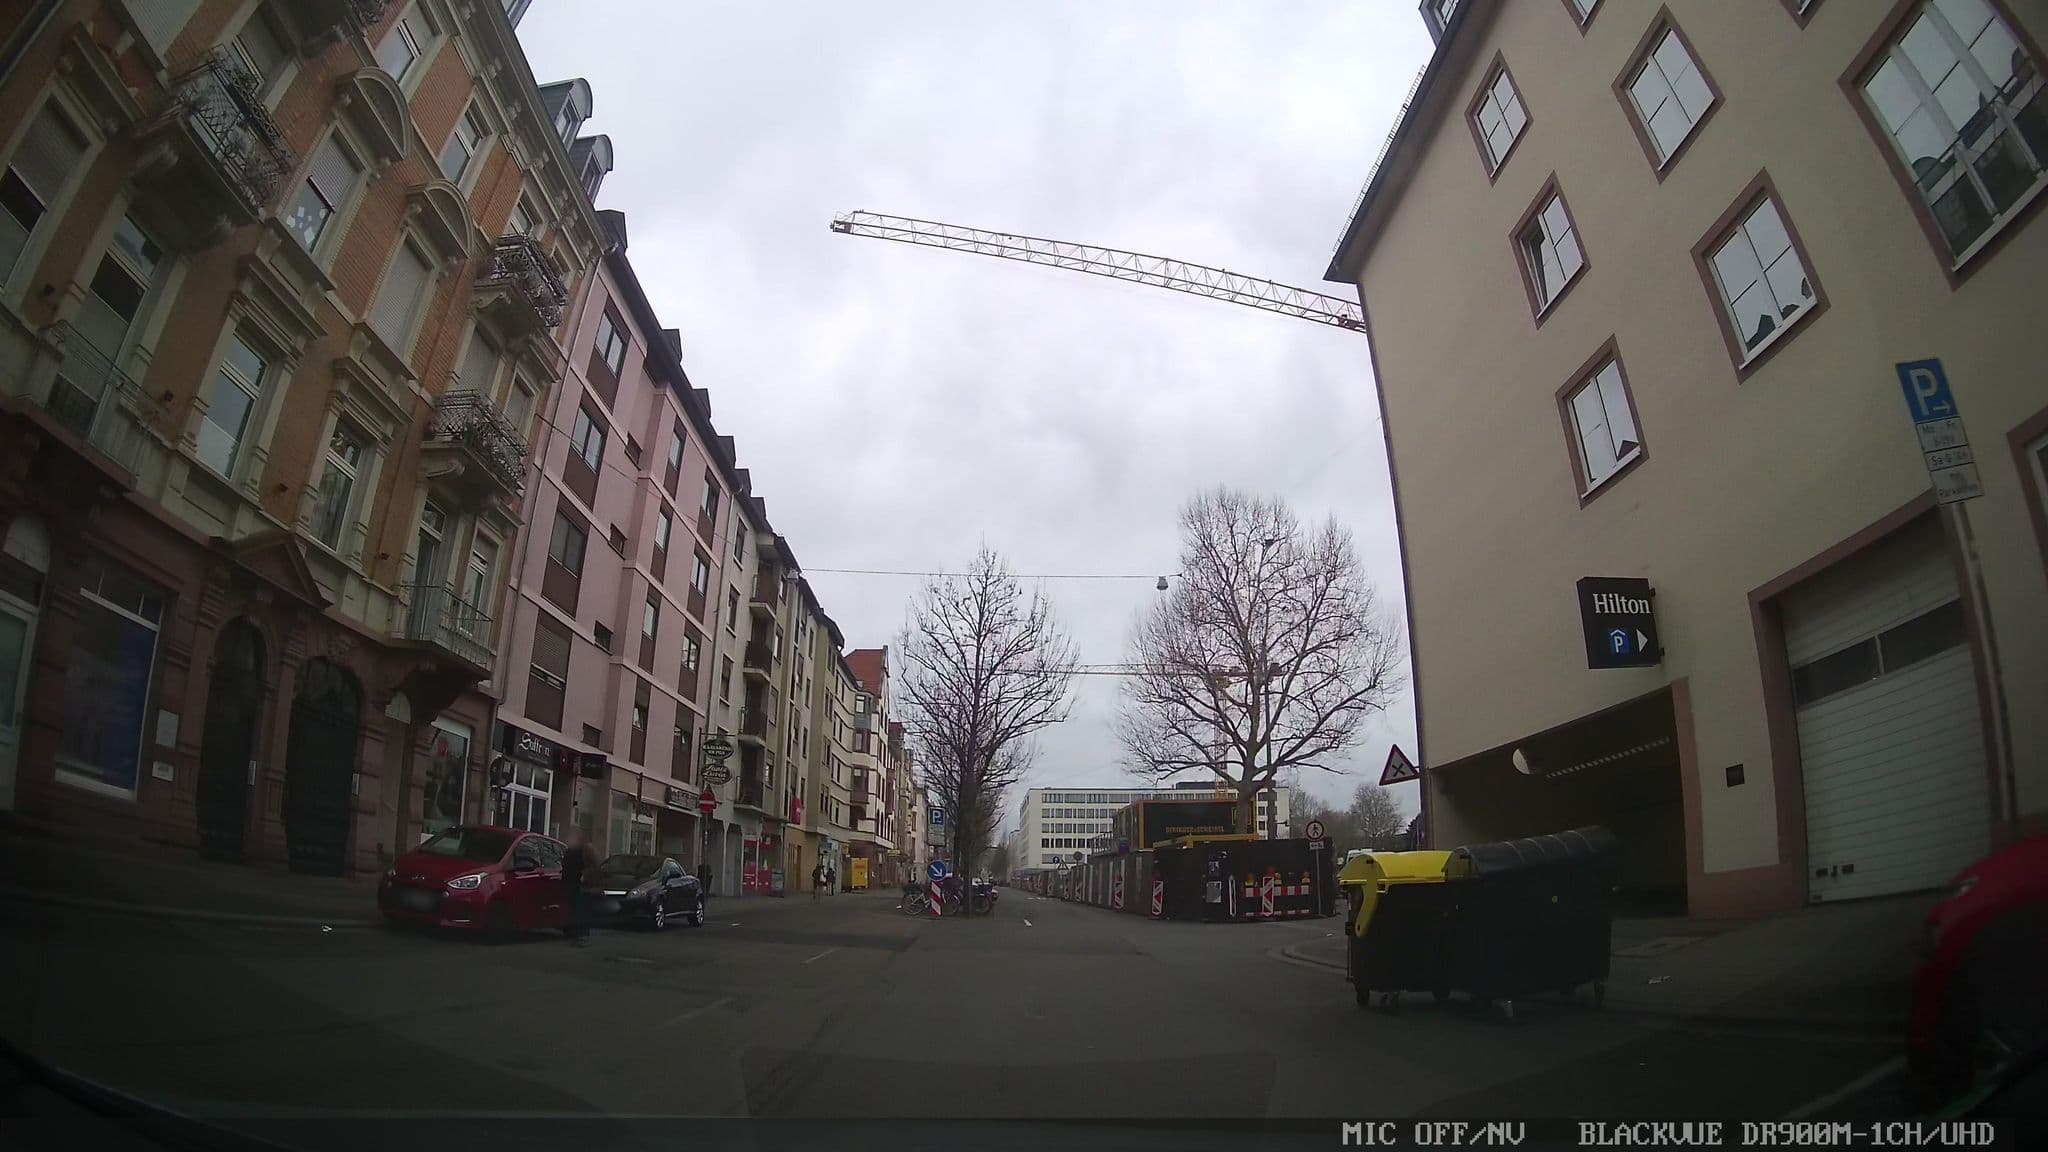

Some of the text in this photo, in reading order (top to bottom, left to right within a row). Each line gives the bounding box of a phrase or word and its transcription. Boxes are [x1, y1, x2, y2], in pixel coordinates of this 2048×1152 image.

[1909, 368, 1938, 416] P
[1592, 593, 1651, 614] Hilton
[1613, 635, 1624, 653] P
[932, 810, 941, 823] P
